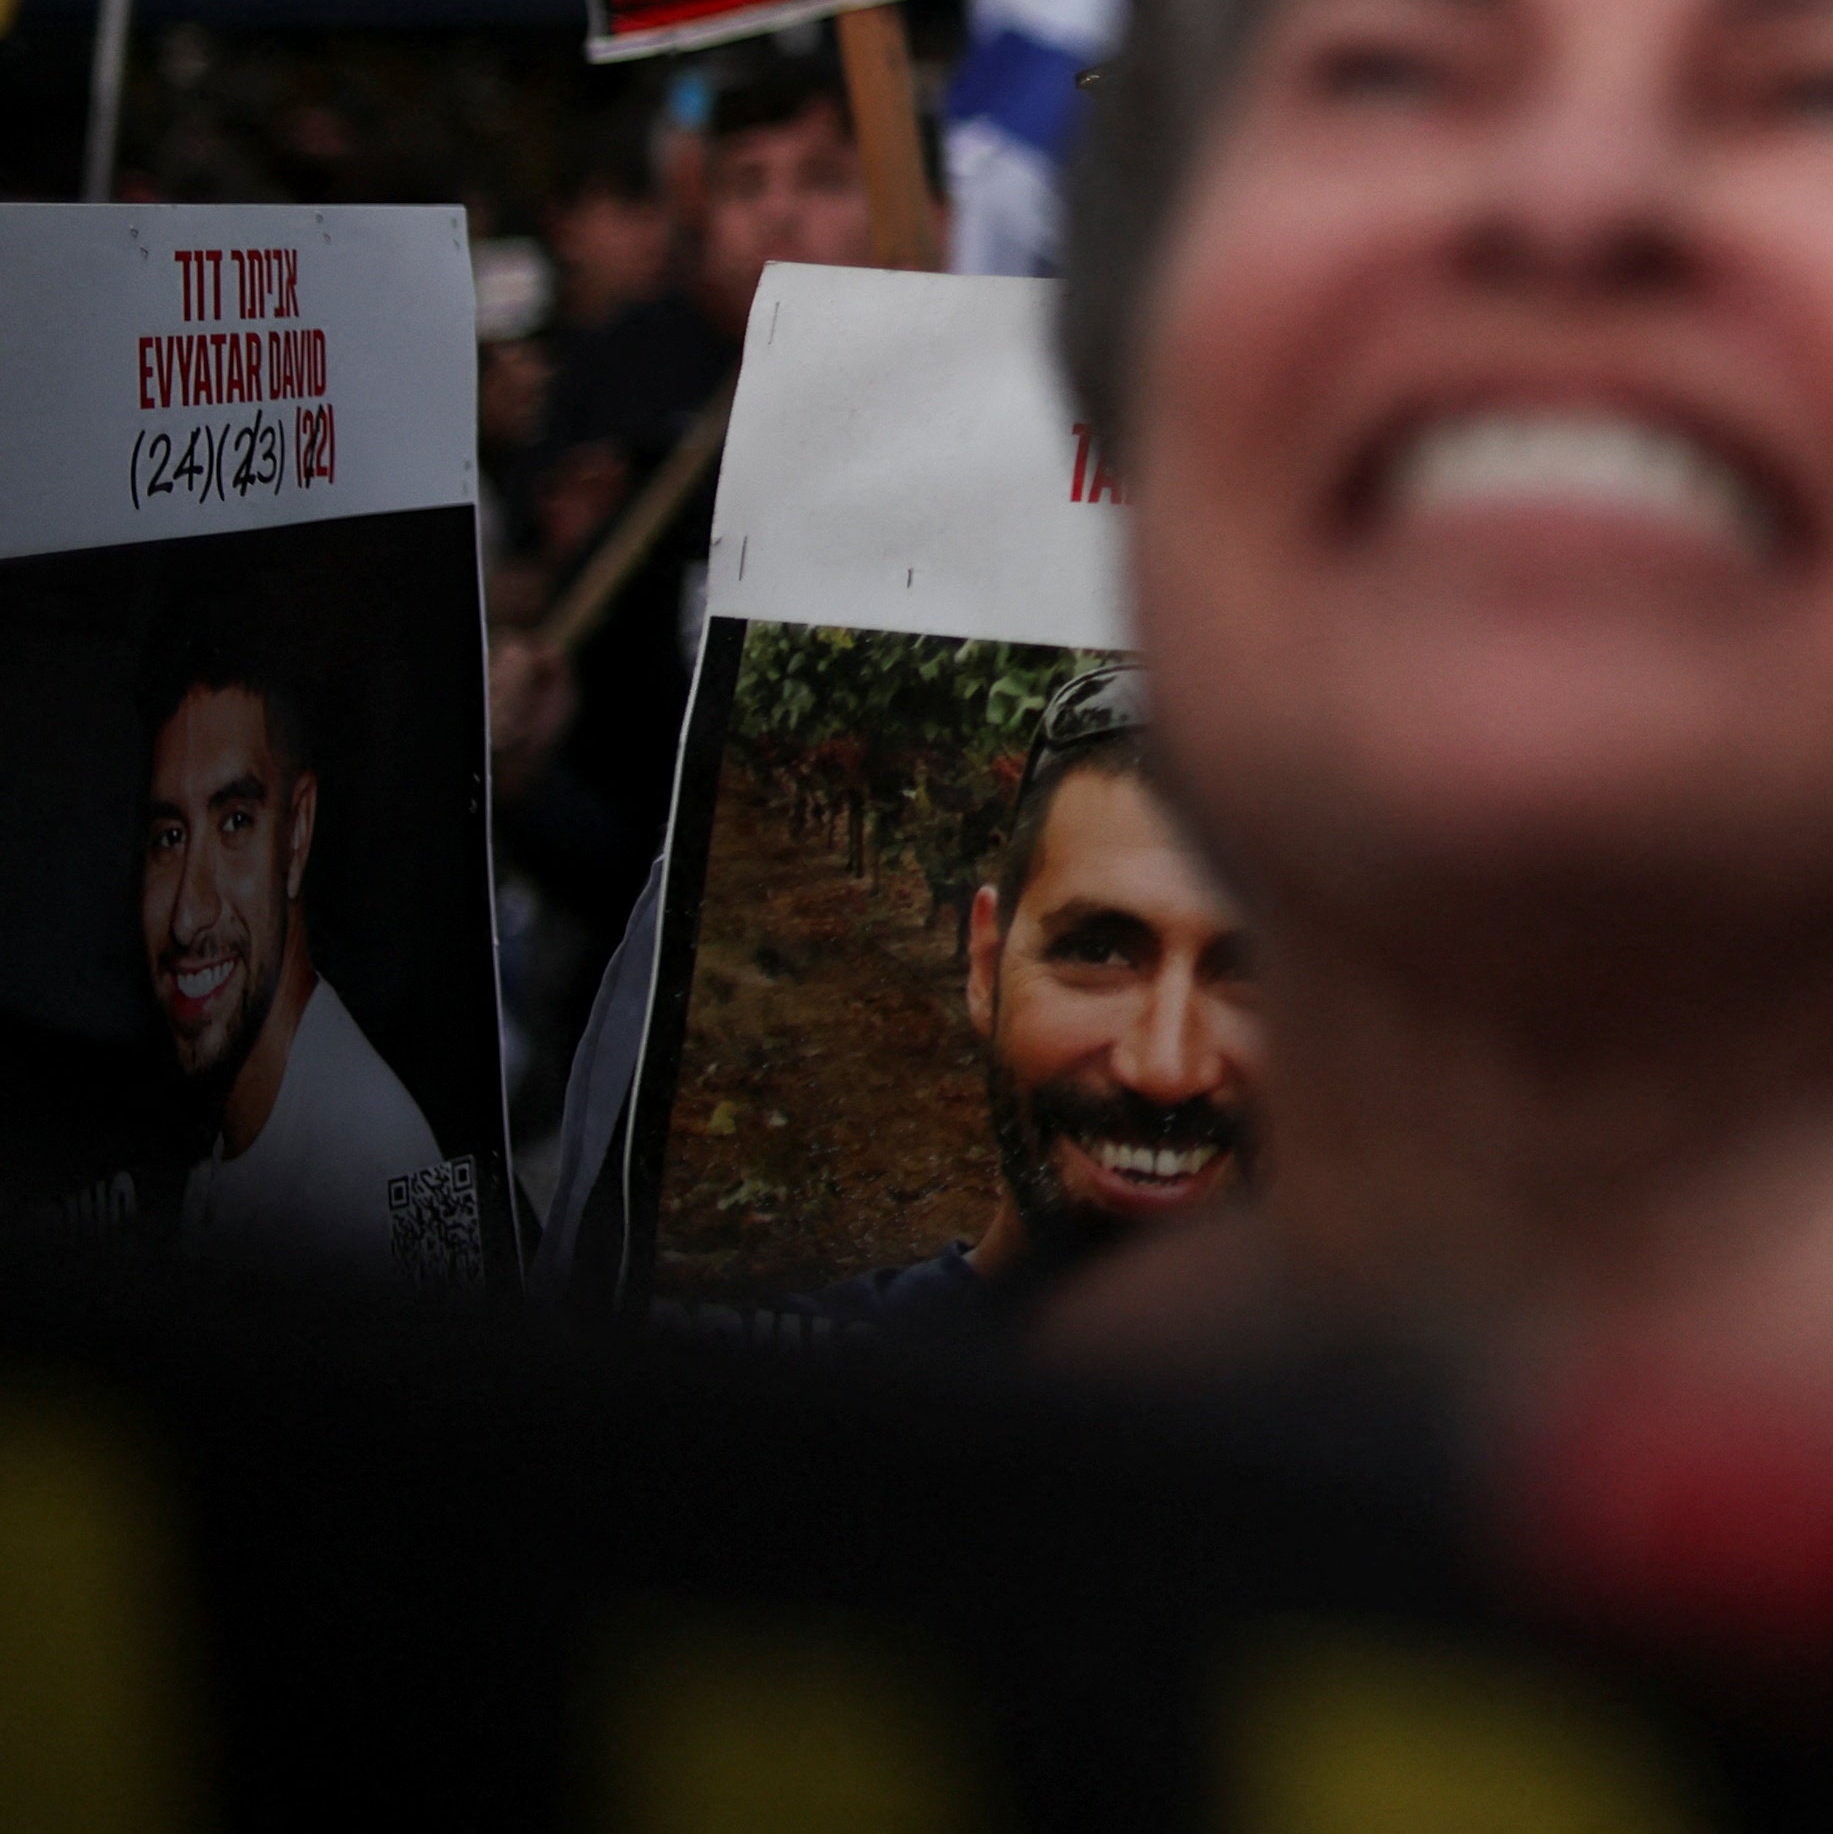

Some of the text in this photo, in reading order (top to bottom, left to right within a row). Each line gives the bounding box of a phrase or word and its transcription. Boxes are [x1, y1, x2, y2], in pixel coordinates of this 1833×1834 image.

[174, 248, 299, 322] אביתר דוד
[138, 328, 327, 410] EVYATAR DAVID
